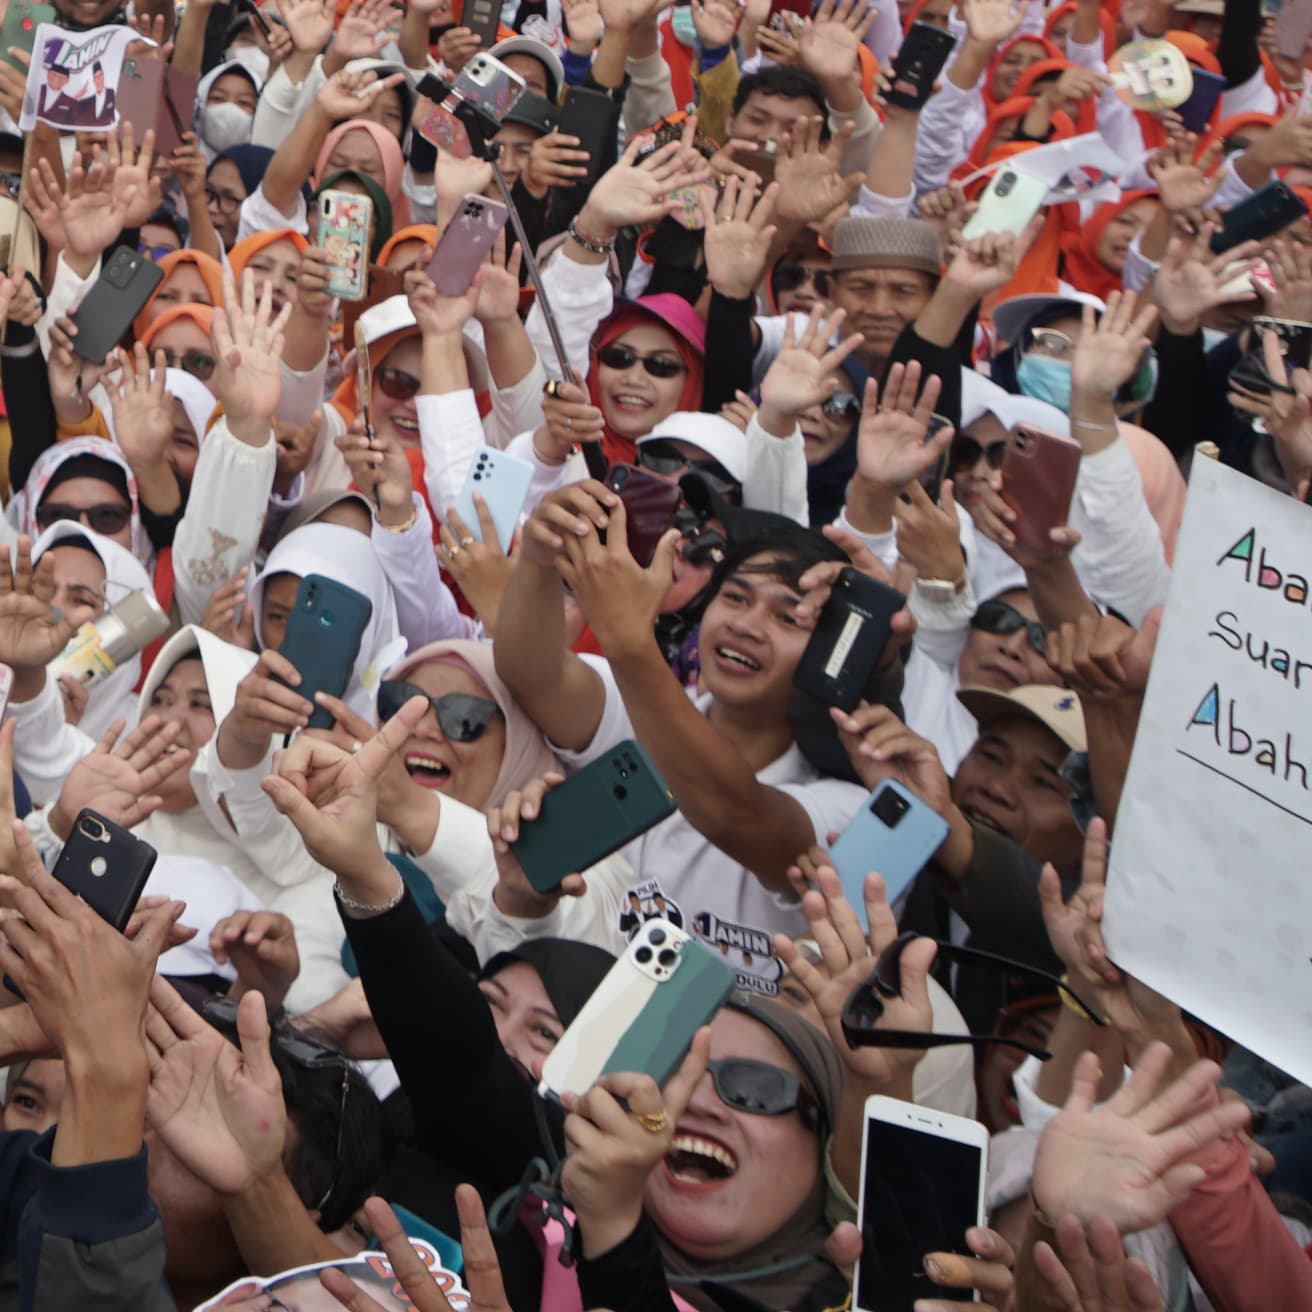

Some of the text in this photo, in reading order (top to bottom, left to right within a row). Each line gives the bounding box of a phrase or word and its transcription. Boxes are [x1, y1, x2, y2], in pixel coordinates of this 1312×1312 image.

[62, 28, 118, 70] AMIN
[1185, 681, 1309, 791] Abah
[716, 928, 772, 958] AMIN
[736, 972, 776, 993] DULU
